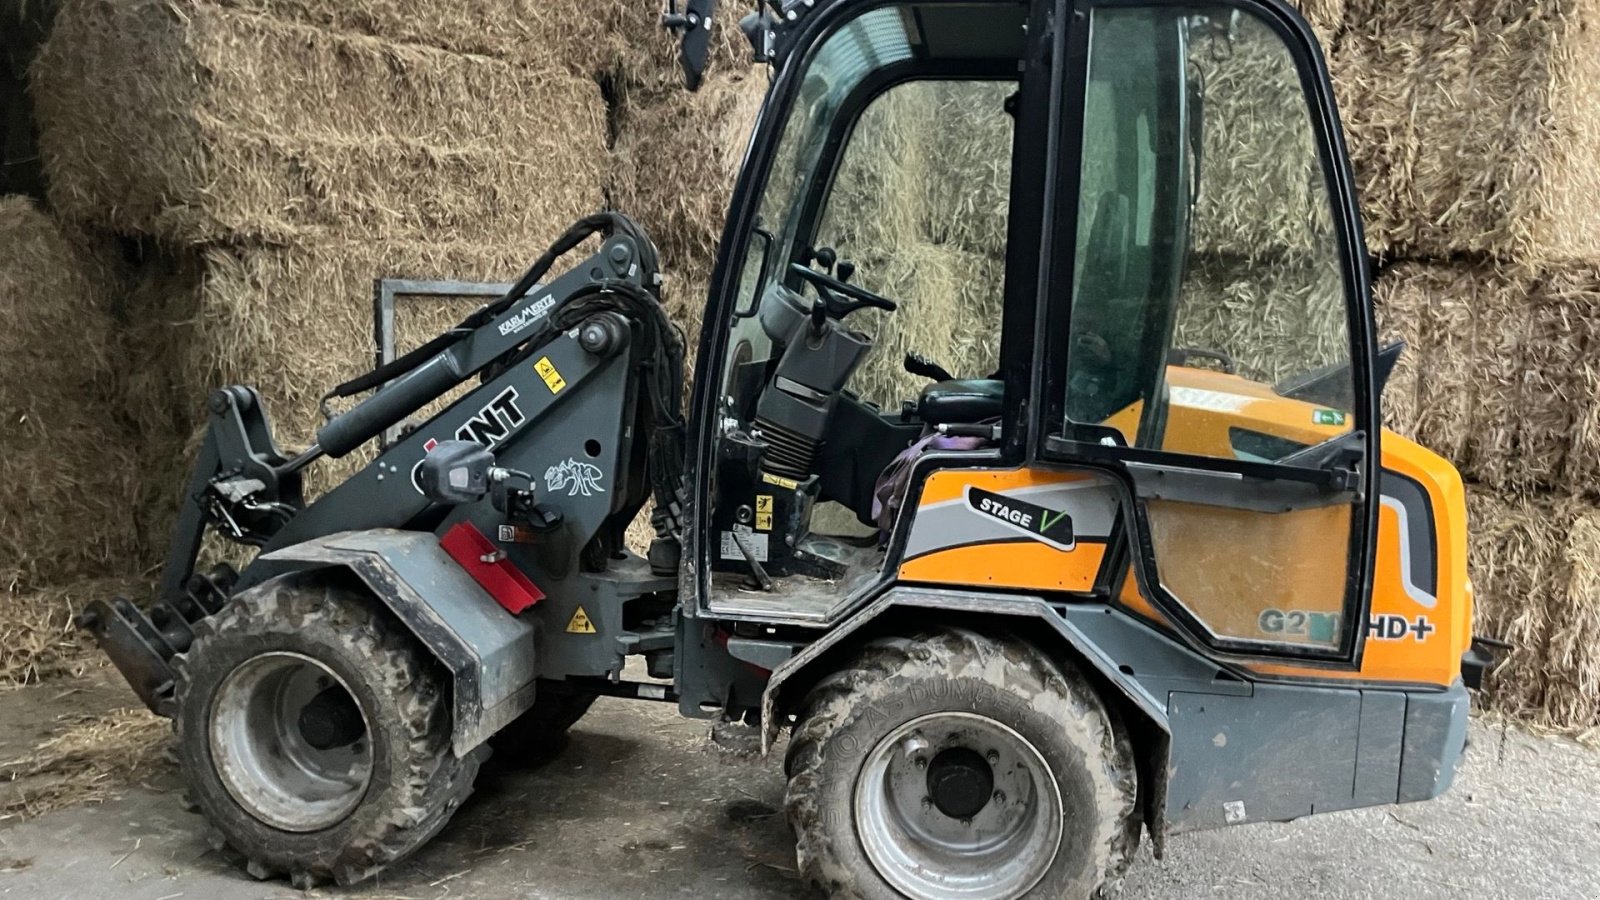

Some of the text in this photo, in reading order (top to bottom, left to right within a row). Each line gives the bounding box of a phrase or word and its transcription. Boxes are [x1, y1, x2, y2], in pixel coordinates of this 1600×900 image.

[498, 314, 524, 336] KARL
[521, 293, 556, 324] MERTZ
[980, 498, 1067, 533] STAGE V
[1366, 613, 1434, 642] HD+
